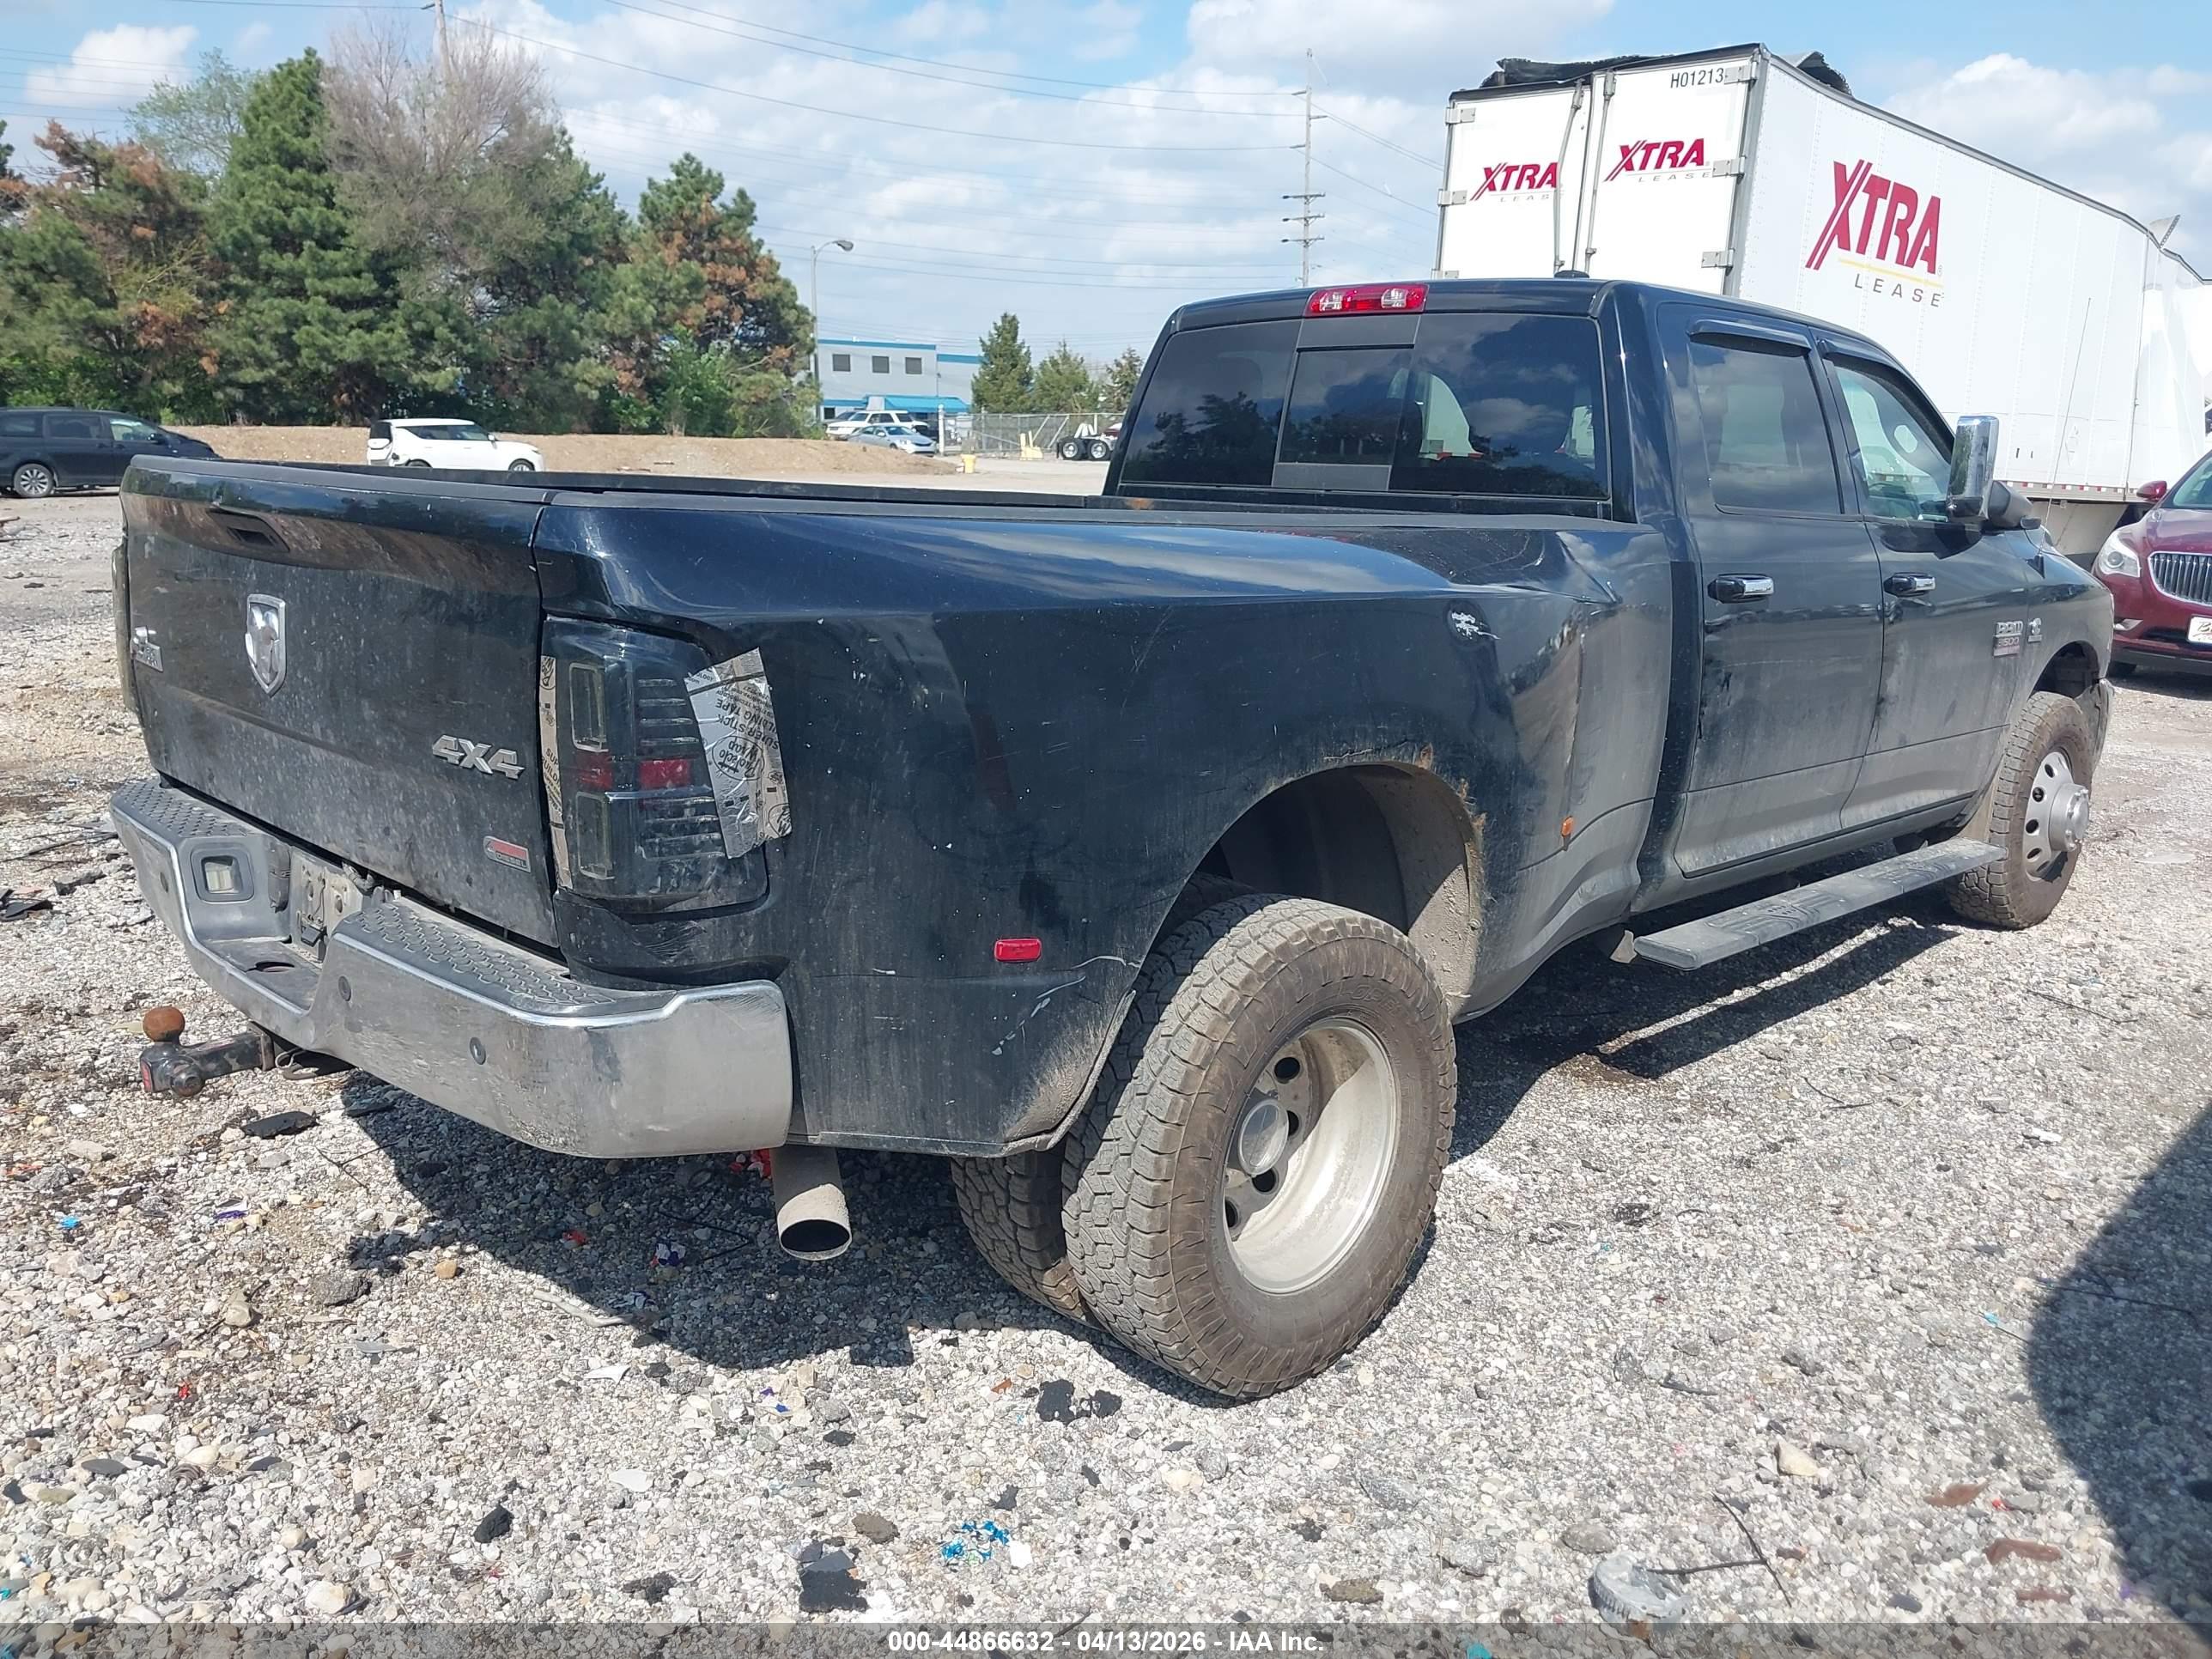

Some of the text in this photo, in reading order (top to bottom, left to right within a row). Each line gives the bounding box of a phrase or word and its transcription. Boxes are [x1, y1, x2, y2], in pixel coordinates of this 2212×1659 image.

[1670, 68, 1724, 88] H01213
[1604, 138, 1705, 182] XTRA
[1638, 172, 1711, 182] LEASE
[1469, 162, 1558, 201] XTRA
[1805, 159, 1941, 275] XTRA
[1854, 273, 1942, 307] LEASE
[714, 698, 742, 716] TAPE
[432, 734, 526, 779] 4X4
